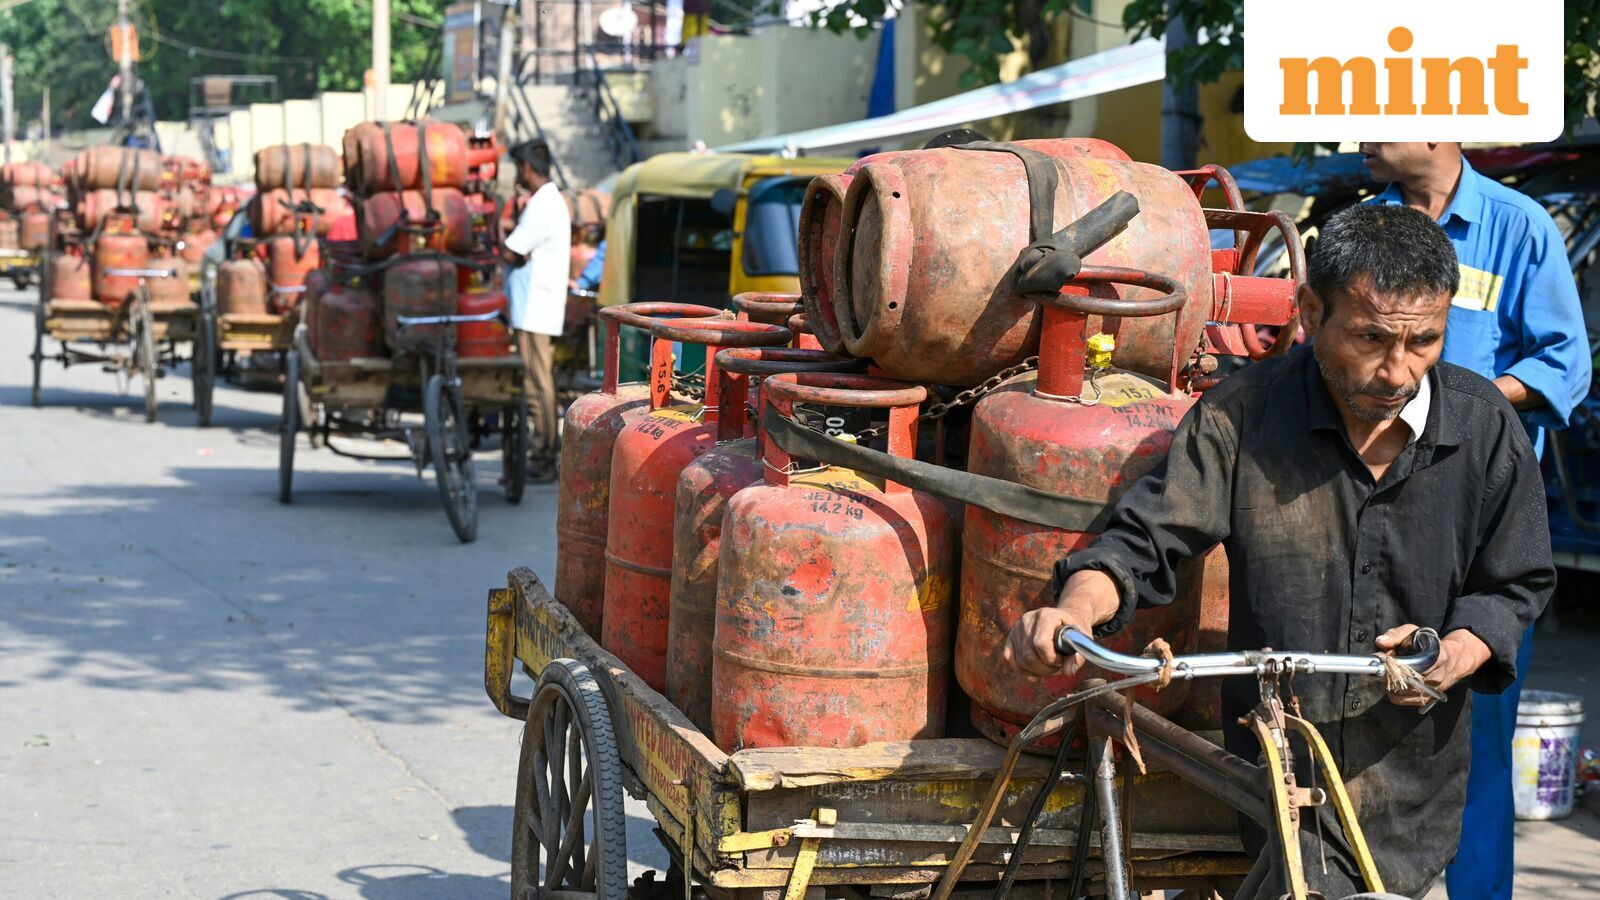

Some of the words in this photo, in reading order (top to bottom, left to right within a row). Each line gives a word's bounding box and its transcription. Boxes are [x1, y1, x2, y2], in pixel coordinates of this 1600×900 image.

[656, 360, 667, 394] 15.6
[1120, 387, 1154, 399] 15.7
[1111, 402, 1151, 414] NETT
[1125, 414, 1156, 428] 14.2
[812, 501, 842, 514] 14.2
[845, 504, 864, 520] kg
